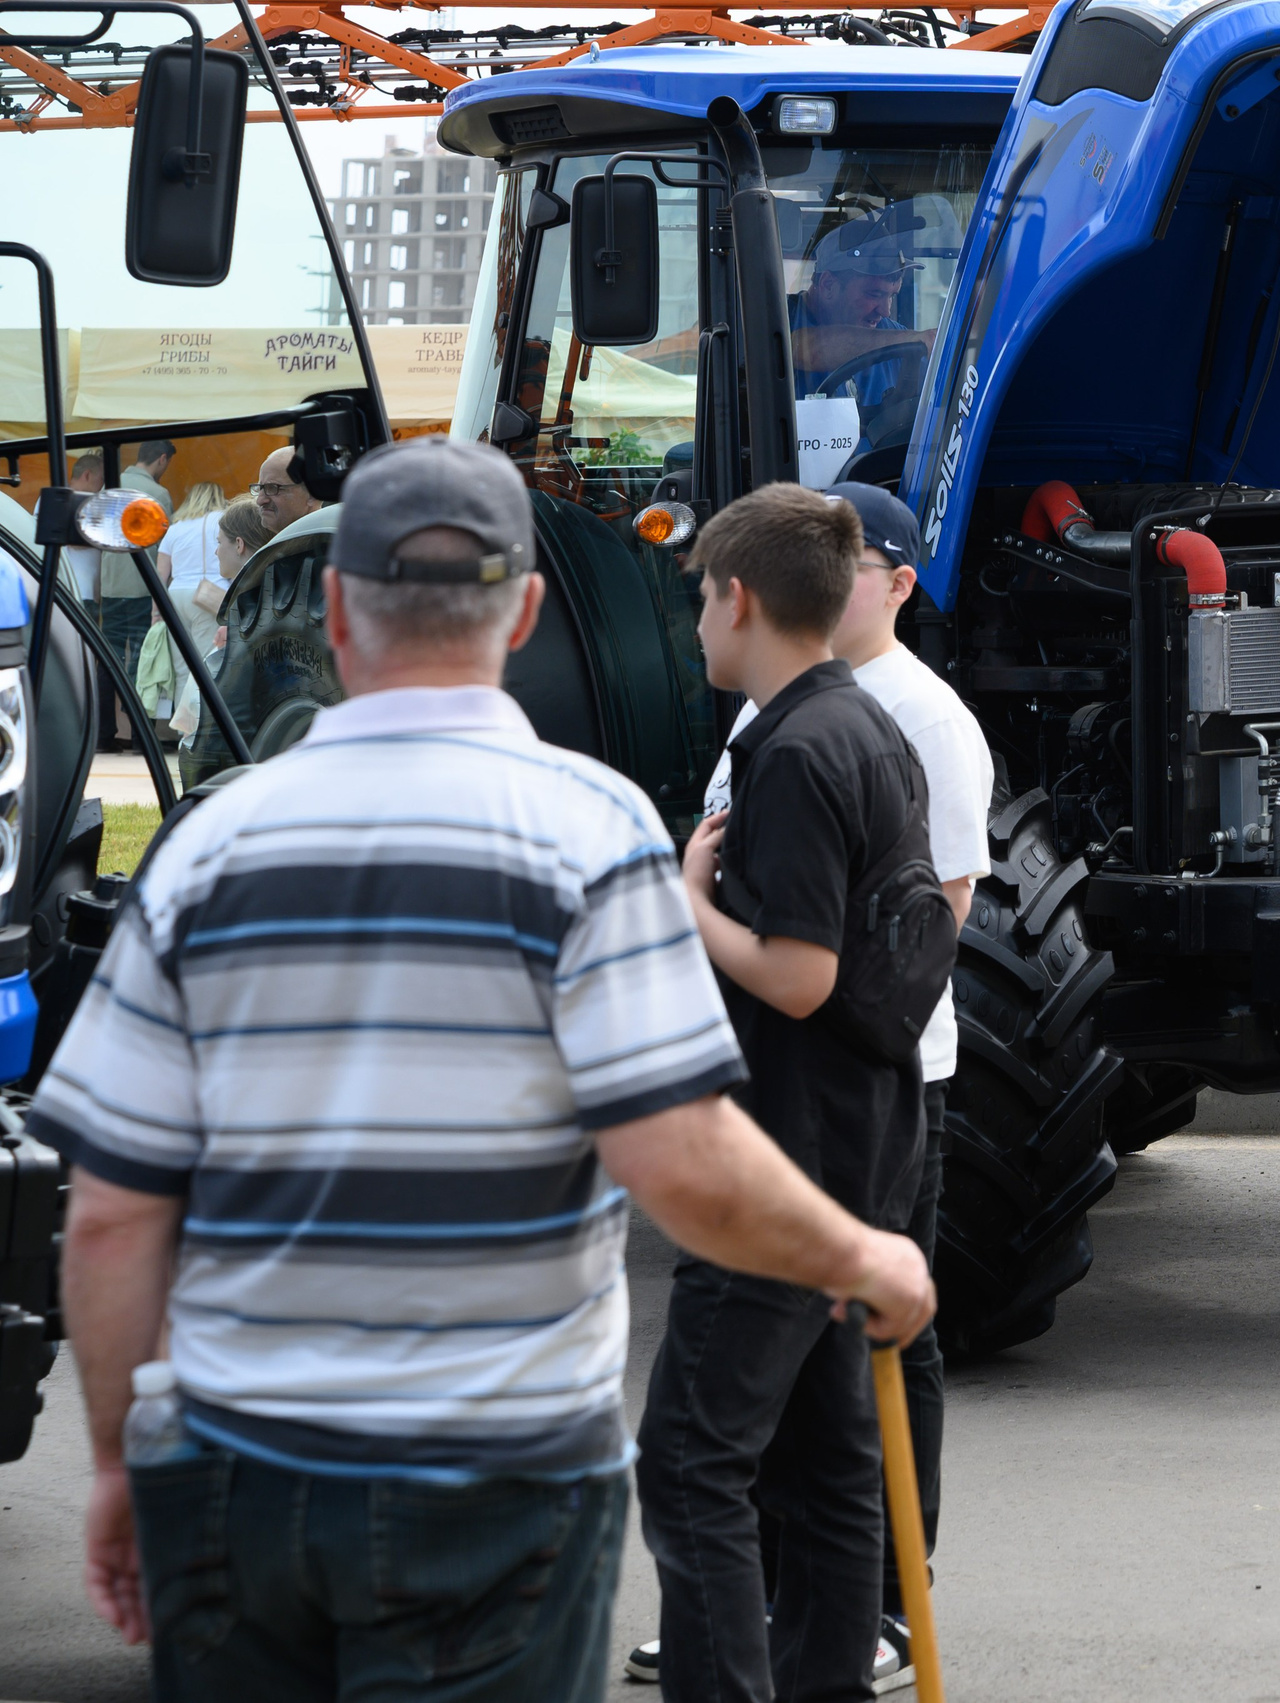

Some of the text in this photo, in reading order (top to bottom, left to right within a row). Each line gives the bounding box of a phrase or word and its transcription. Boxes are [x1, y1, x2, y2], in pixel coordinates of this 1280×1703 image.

[160, 333, 212, 346] ЯГОДЫ
[265, 332, 353, 357] АРОМАТЫ
[422, 332, 463, 346] КЕДР
[159, 350, 210, 363] ГРИБЫ
[277, 352, 337, 373] ТАЙГИ
[830, 437, 852, 450] 2025
